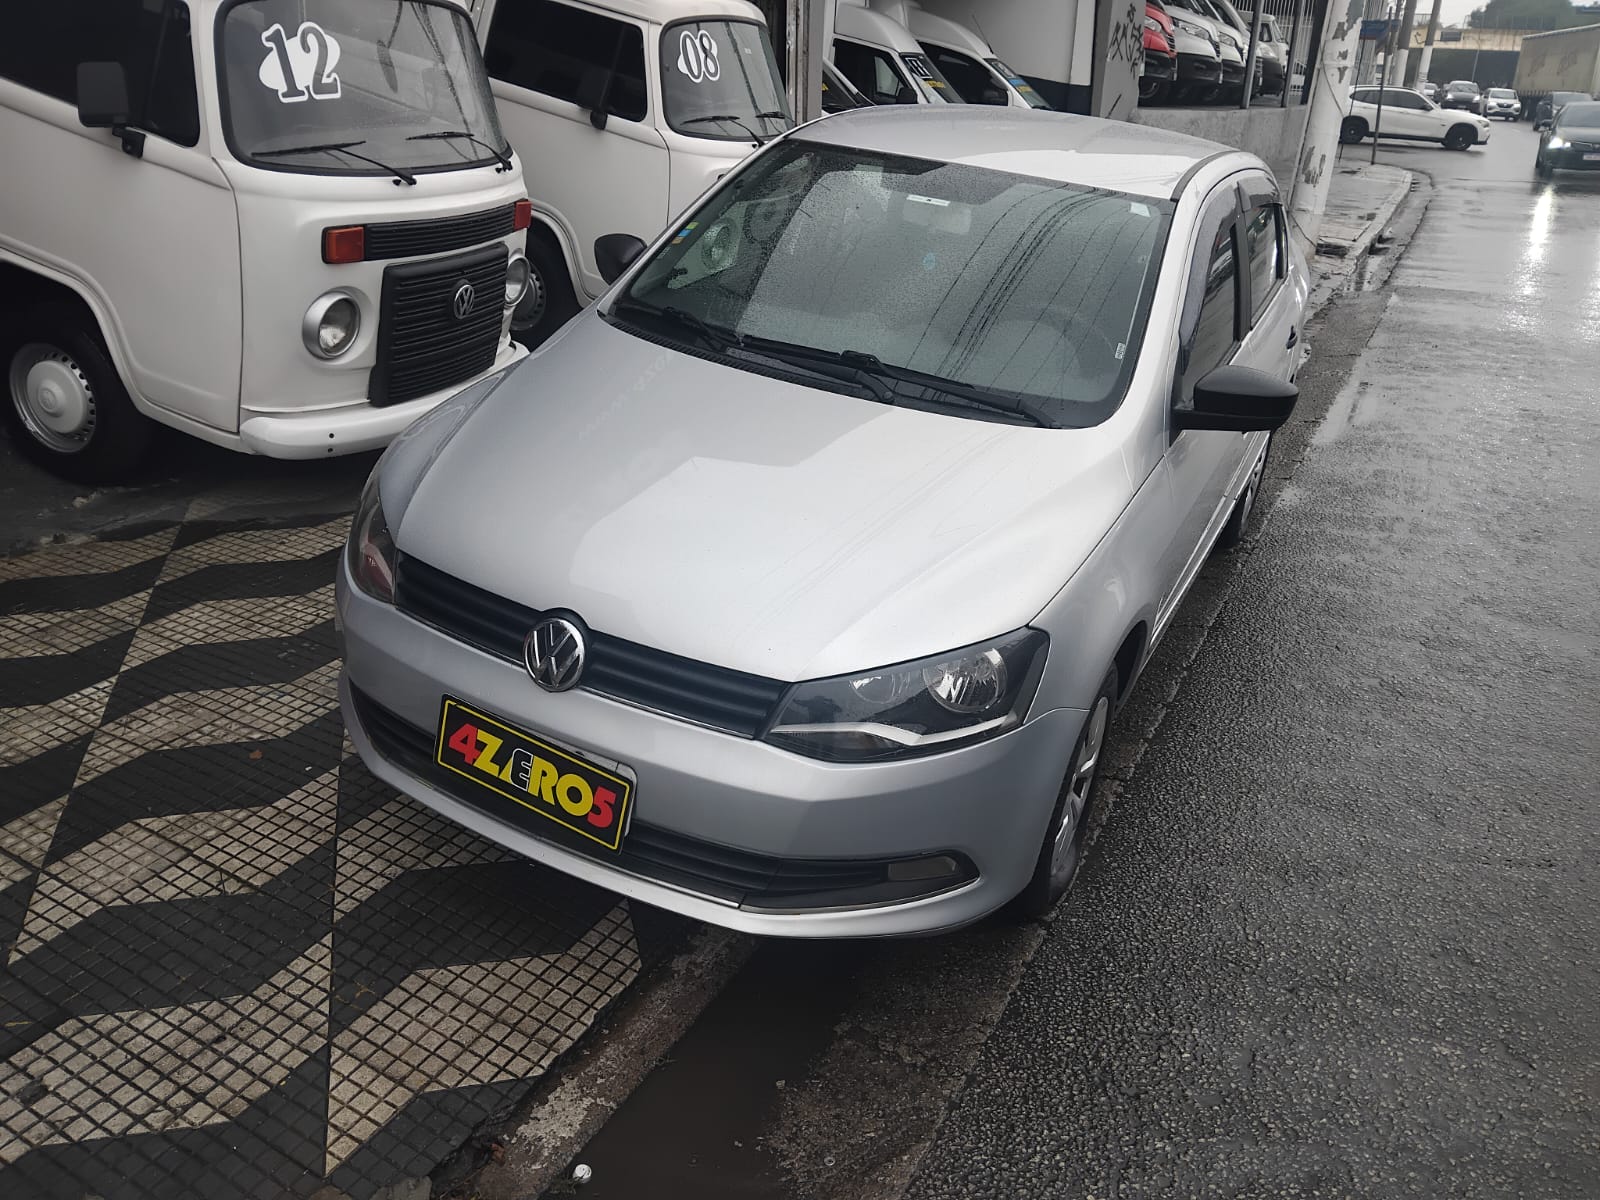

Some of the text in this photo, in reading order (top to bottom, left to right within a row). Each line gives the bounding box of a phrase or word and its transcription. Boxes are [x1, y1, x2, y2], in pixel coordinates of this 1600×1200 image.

[261, 21, 341, 103] 12
[679, 29, 720, 83] 08
[448, 723, 617, 828] 4ZERO5
